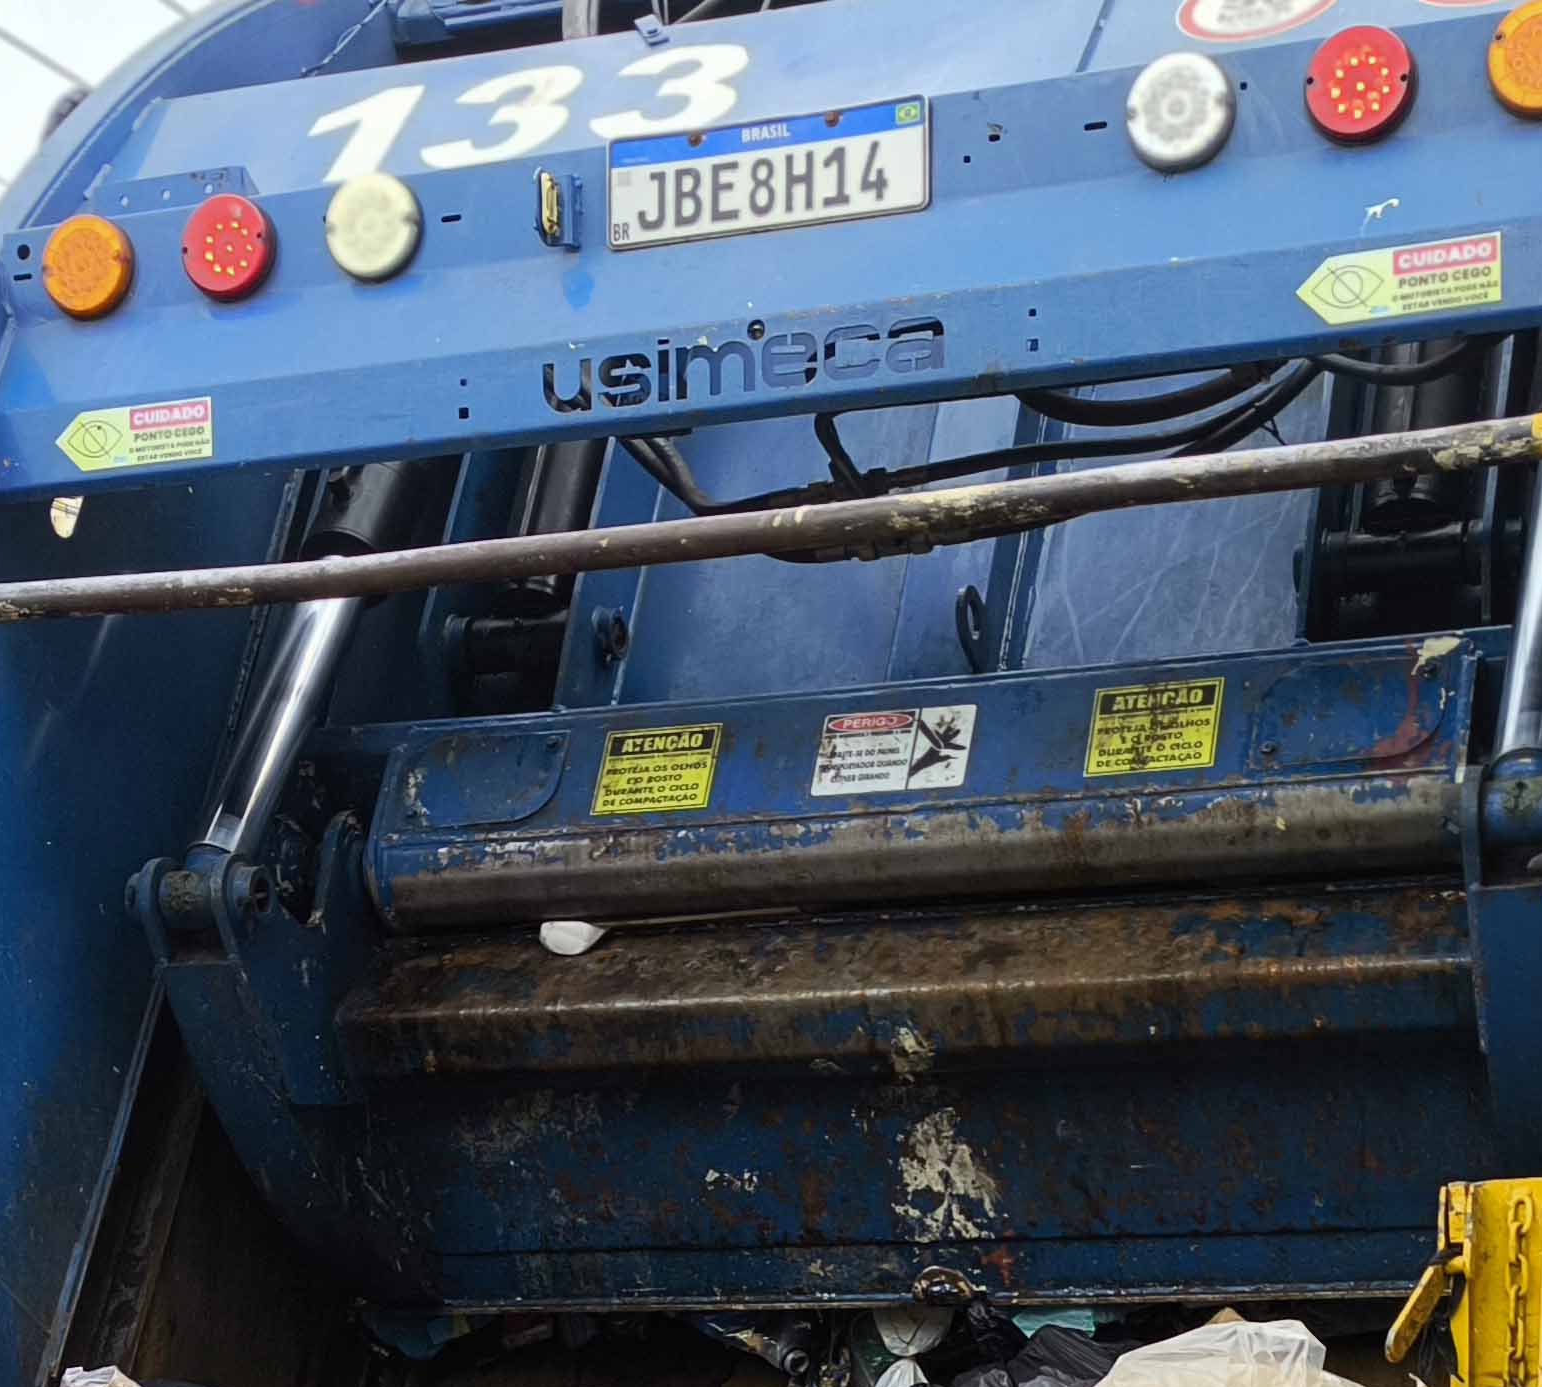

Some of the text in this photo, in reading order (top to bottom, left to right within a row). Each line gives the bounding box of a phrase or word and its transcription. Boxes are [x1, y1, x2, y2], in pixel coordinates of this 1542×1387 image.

[308, 43, 750, 183] 133
[741, 124, 791, 144] BRASIL
[637, 140, 889, 232] JBE8H14
[612, 222, 631, 242] BR
[1398, 241, 1492, 269] CUIDADO
[1399, 265, 1492, 288] PONTO CEGO
[542, 316, 945, 414] usimeca
[133, 404, 205, 426] CUIDADO
[133, 430, 171, 443] PONTO
[1157, 743, 1165, 751] O
[1170, 740, 1204, 750] CICLO
[654, 764, 668, 773] OS
[671, 761, 708, 771] OLHOS
[1096, 759, 1112, 768] DE
[646, 774, 683, 784] ROSTO
[604, 782, 700, 797] DURANTE O CICLO
[603, 793, 698, 807] DE COMPACTAÇÃO
